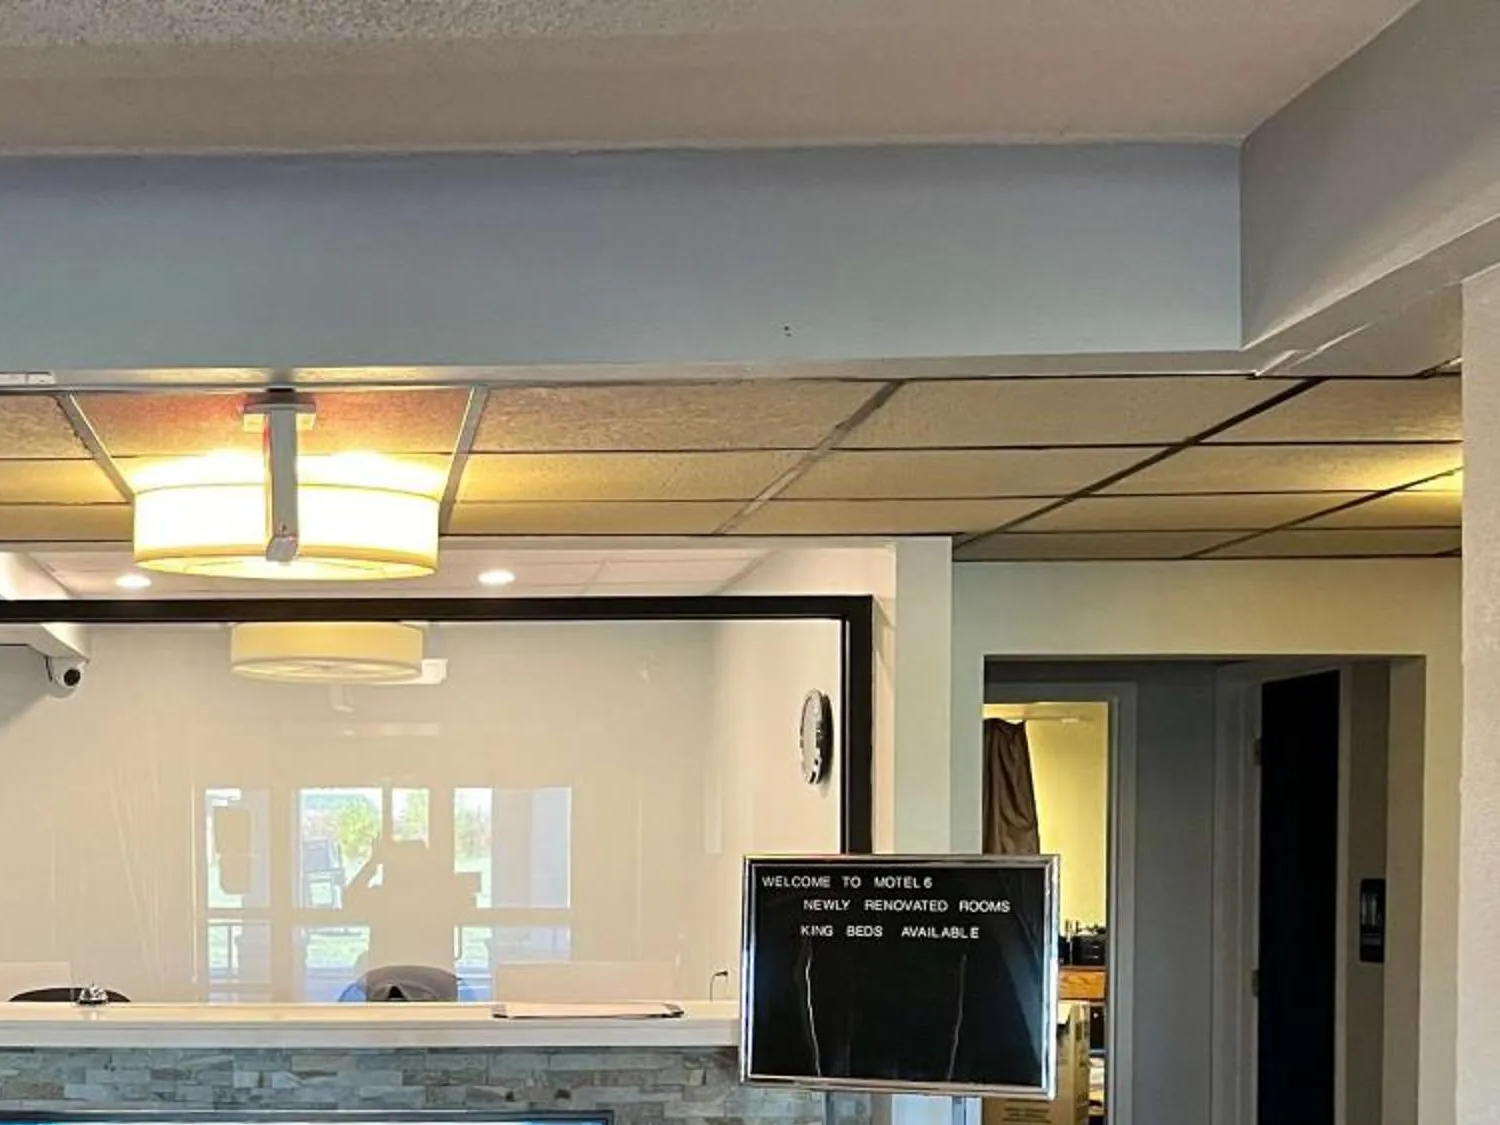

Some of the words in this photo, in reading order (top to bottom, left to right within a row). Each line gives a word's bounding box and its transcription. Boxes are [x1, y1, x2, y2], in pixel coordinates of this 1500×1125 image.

[761, 875, 831, 888] WELCOME
[841, 875, 862, 889] TO
[803, 899, 851, 911] NEWLY
[864, 899, 949, 912] RENOVATED
[959, 900, 1011, 913] ROOMS
[800, 925, 834, 937] KING
[846, 925, 884, 937] BEDS
[901, 925, 980, 939] AVAILABLE
